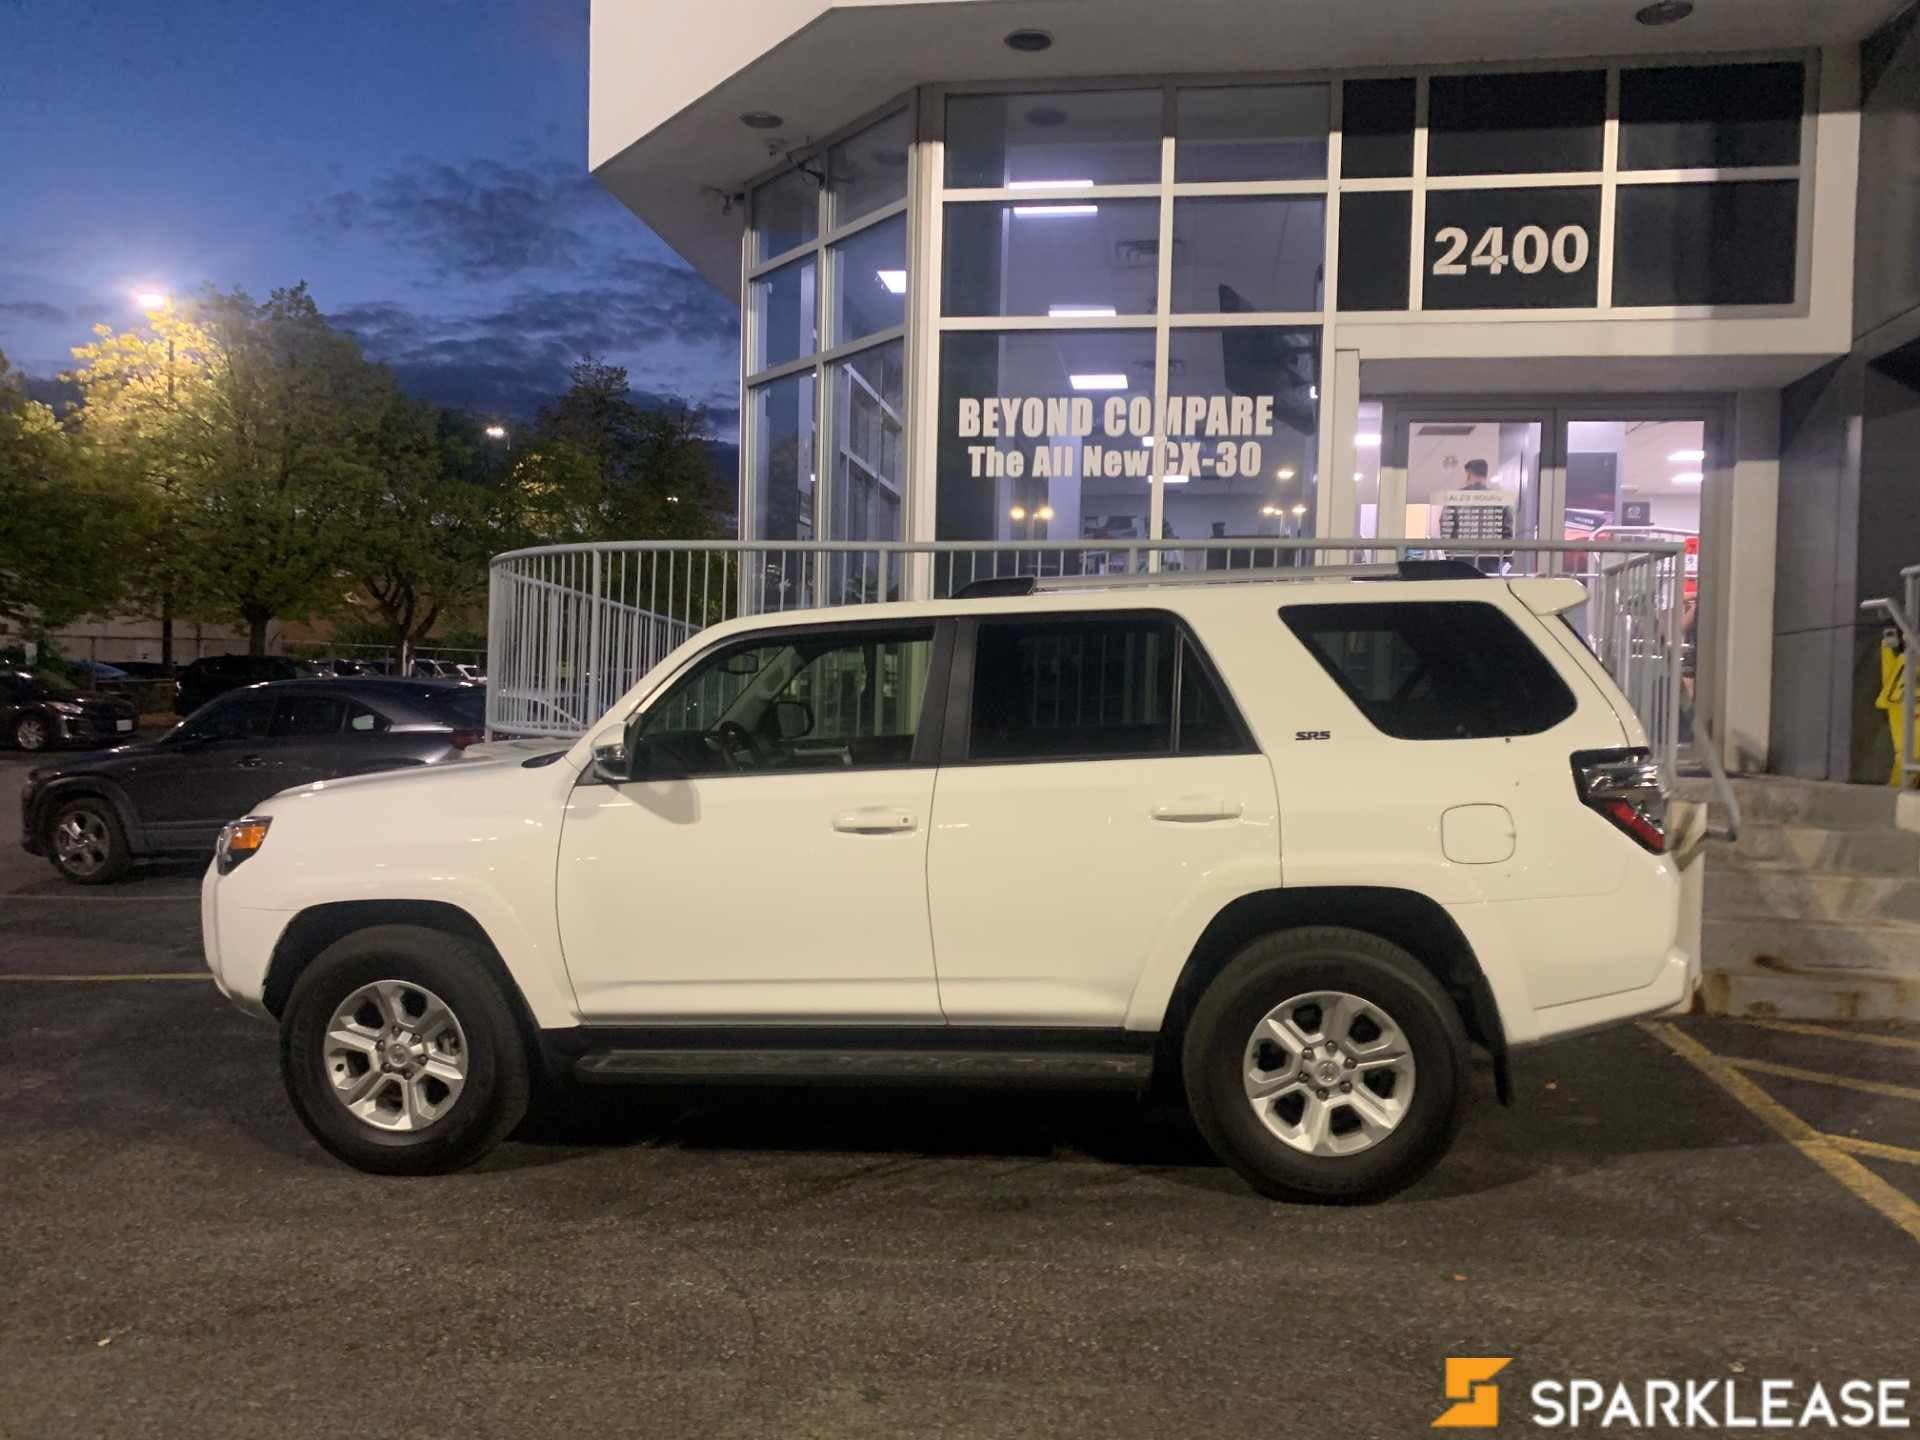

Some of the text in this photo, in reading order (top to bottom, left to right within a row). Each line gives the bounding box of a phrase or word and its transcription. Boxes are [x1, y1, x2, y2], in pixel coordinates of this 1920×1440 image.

[1433, 225, 1589, 275] 2400
[959, 396, 1274, 437] BEYOND COMPARE
[968, 446, 1024, 477] The
[1032, 446, 1073, 477] All
[1083, 445, 1150, 477] New
[1295, 731, 1331, 741] SR5
